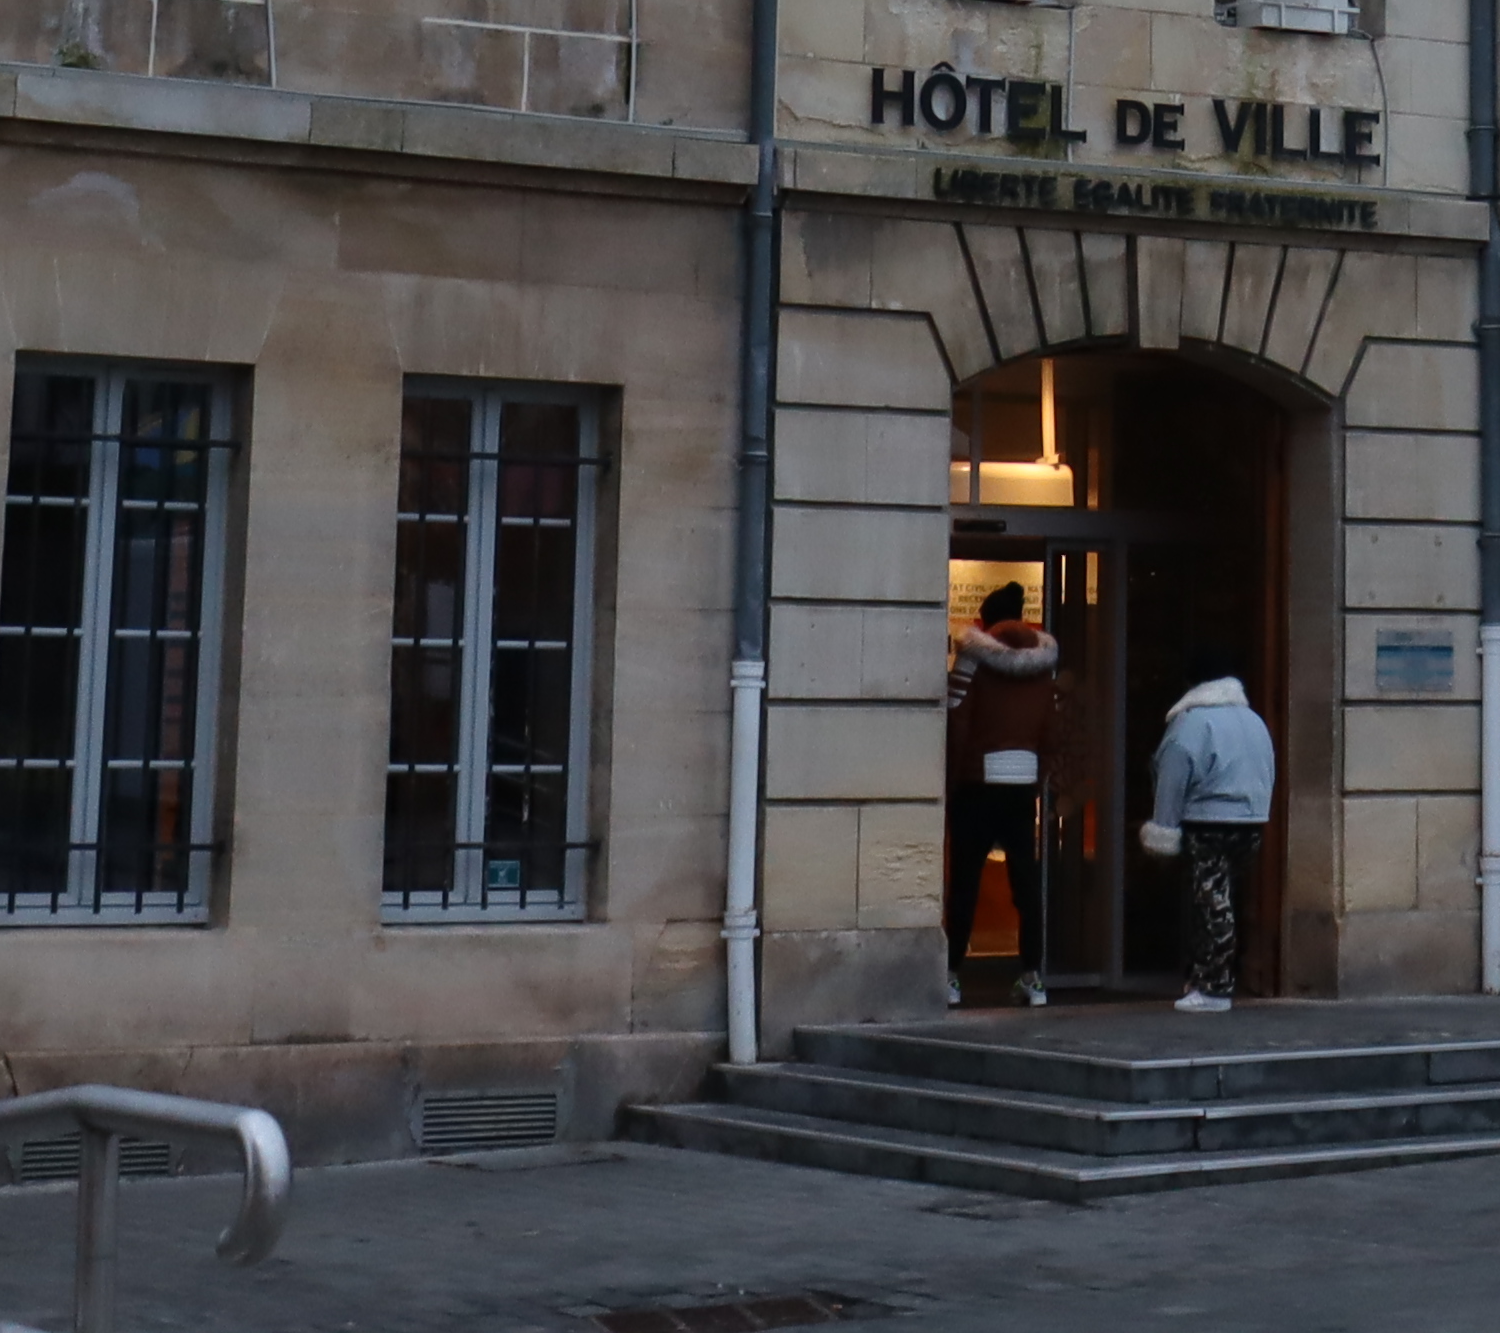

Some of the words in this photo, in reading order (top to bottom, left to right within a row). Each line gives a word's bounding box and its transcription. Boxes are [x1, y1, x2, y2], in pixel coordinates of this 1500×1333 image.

[871, 61, 1088, 145] HÔTEL
[1116, 98, 1185, 152] DE
[1213, 98, 1381, 167] VILLE
